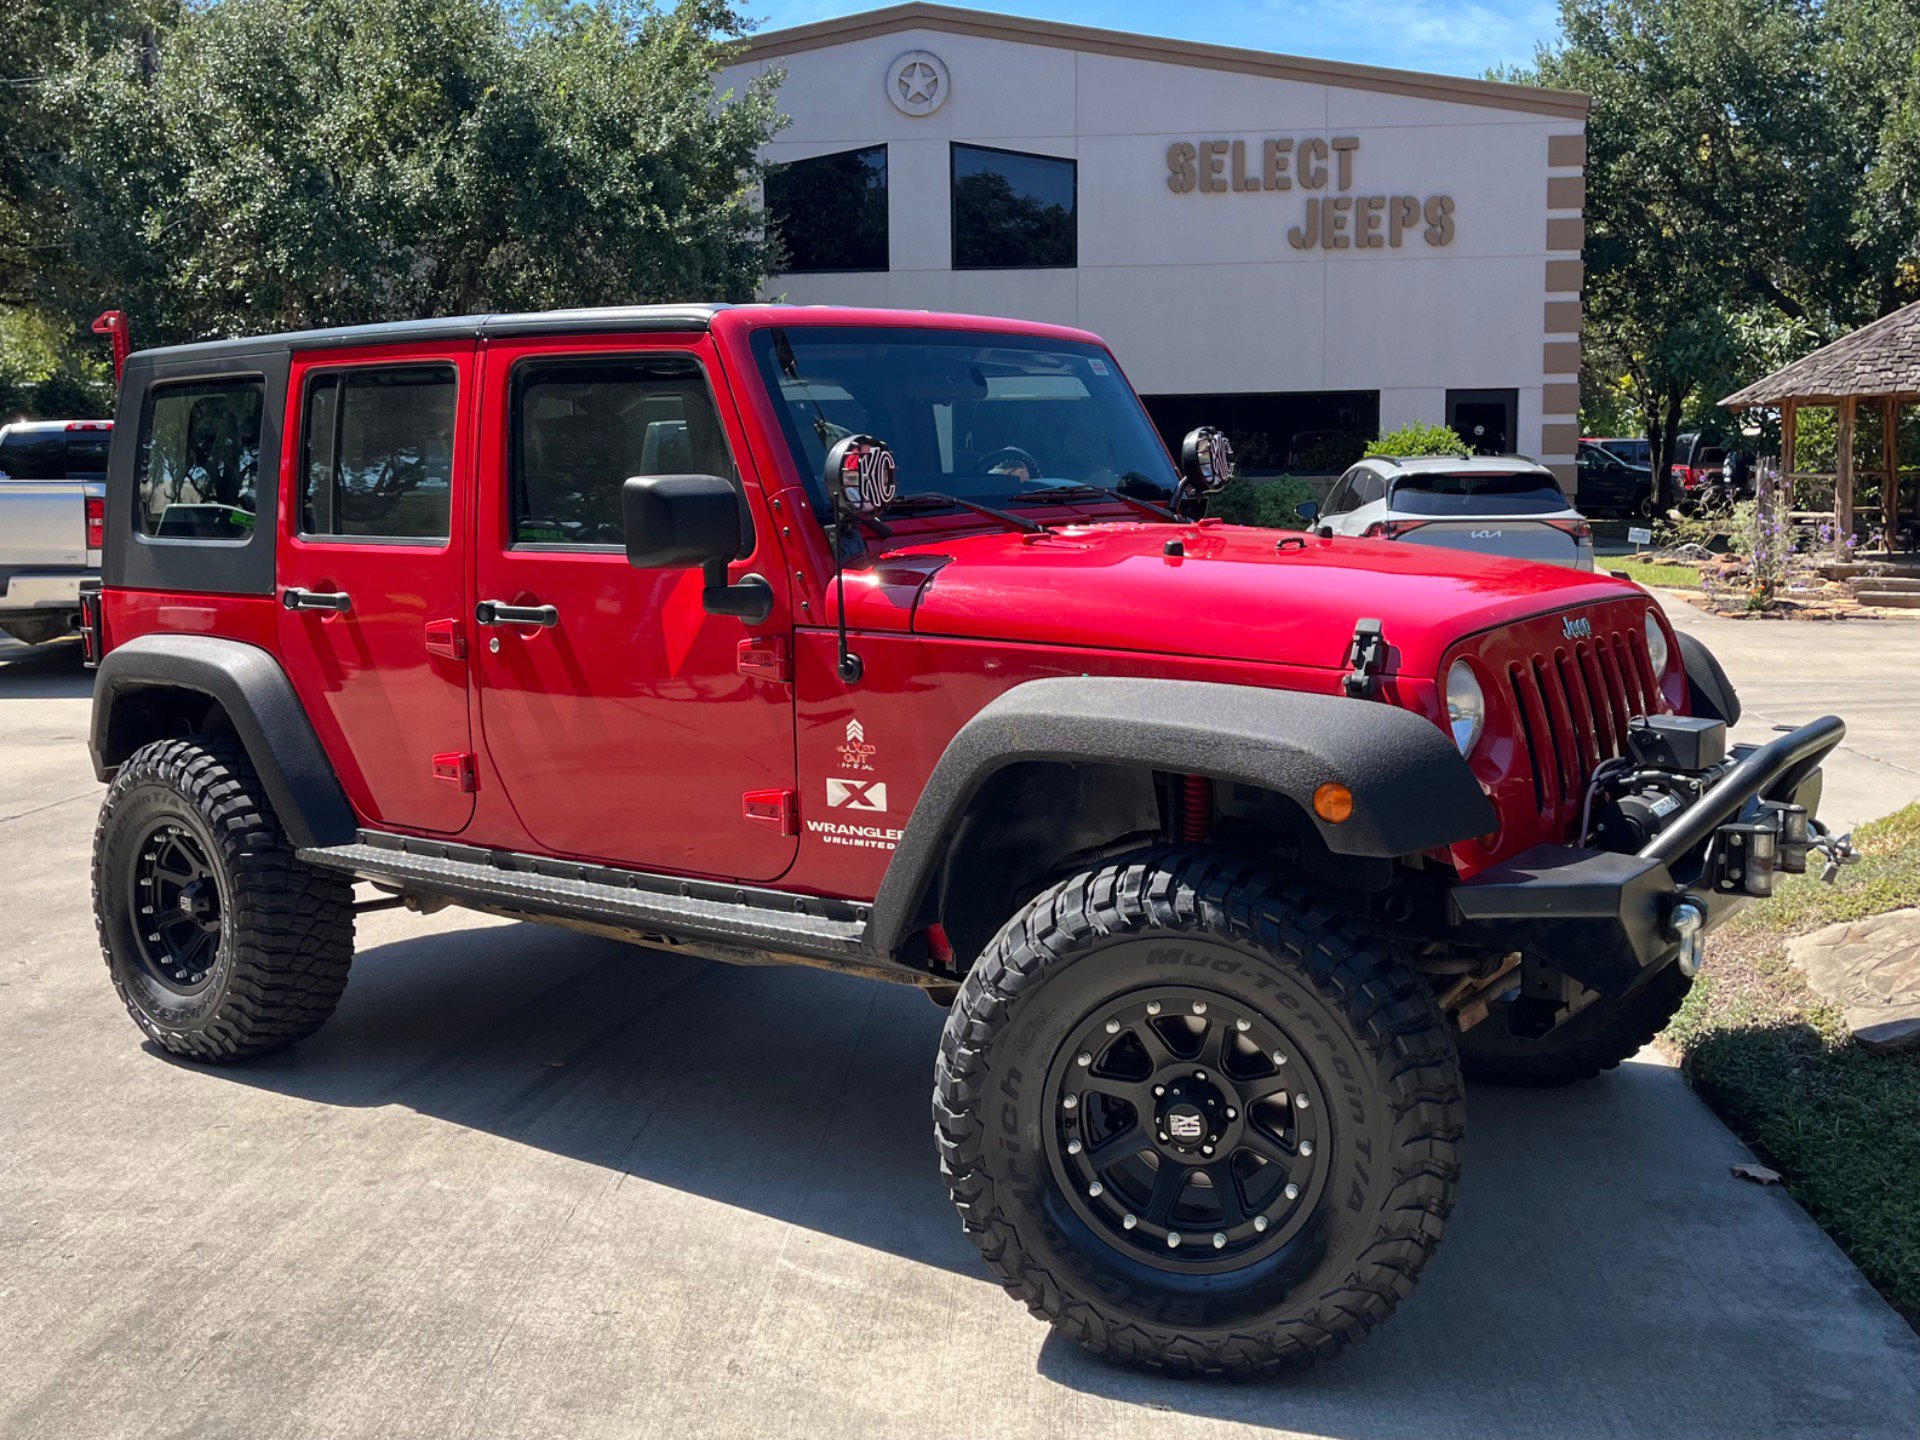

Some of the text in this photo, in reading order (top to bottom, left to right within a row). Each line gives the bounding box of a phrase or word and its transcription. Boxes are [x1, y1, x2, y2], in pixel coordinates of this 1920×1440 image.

[1166, 137, 1360, 193] SELECT
[1287, 195, 1456, 249] JEEPS
[860, 446, 896, 507] KC
[1211, 434, 1234, 480] KC
[1562, 616, 1592, 640] Jeep
[823, 835, 896, 850] UNLIMITED
[1145, 946, 1368, 1124] Mud-Terrain
[1346, 1136, 1374, 1213] T/A
